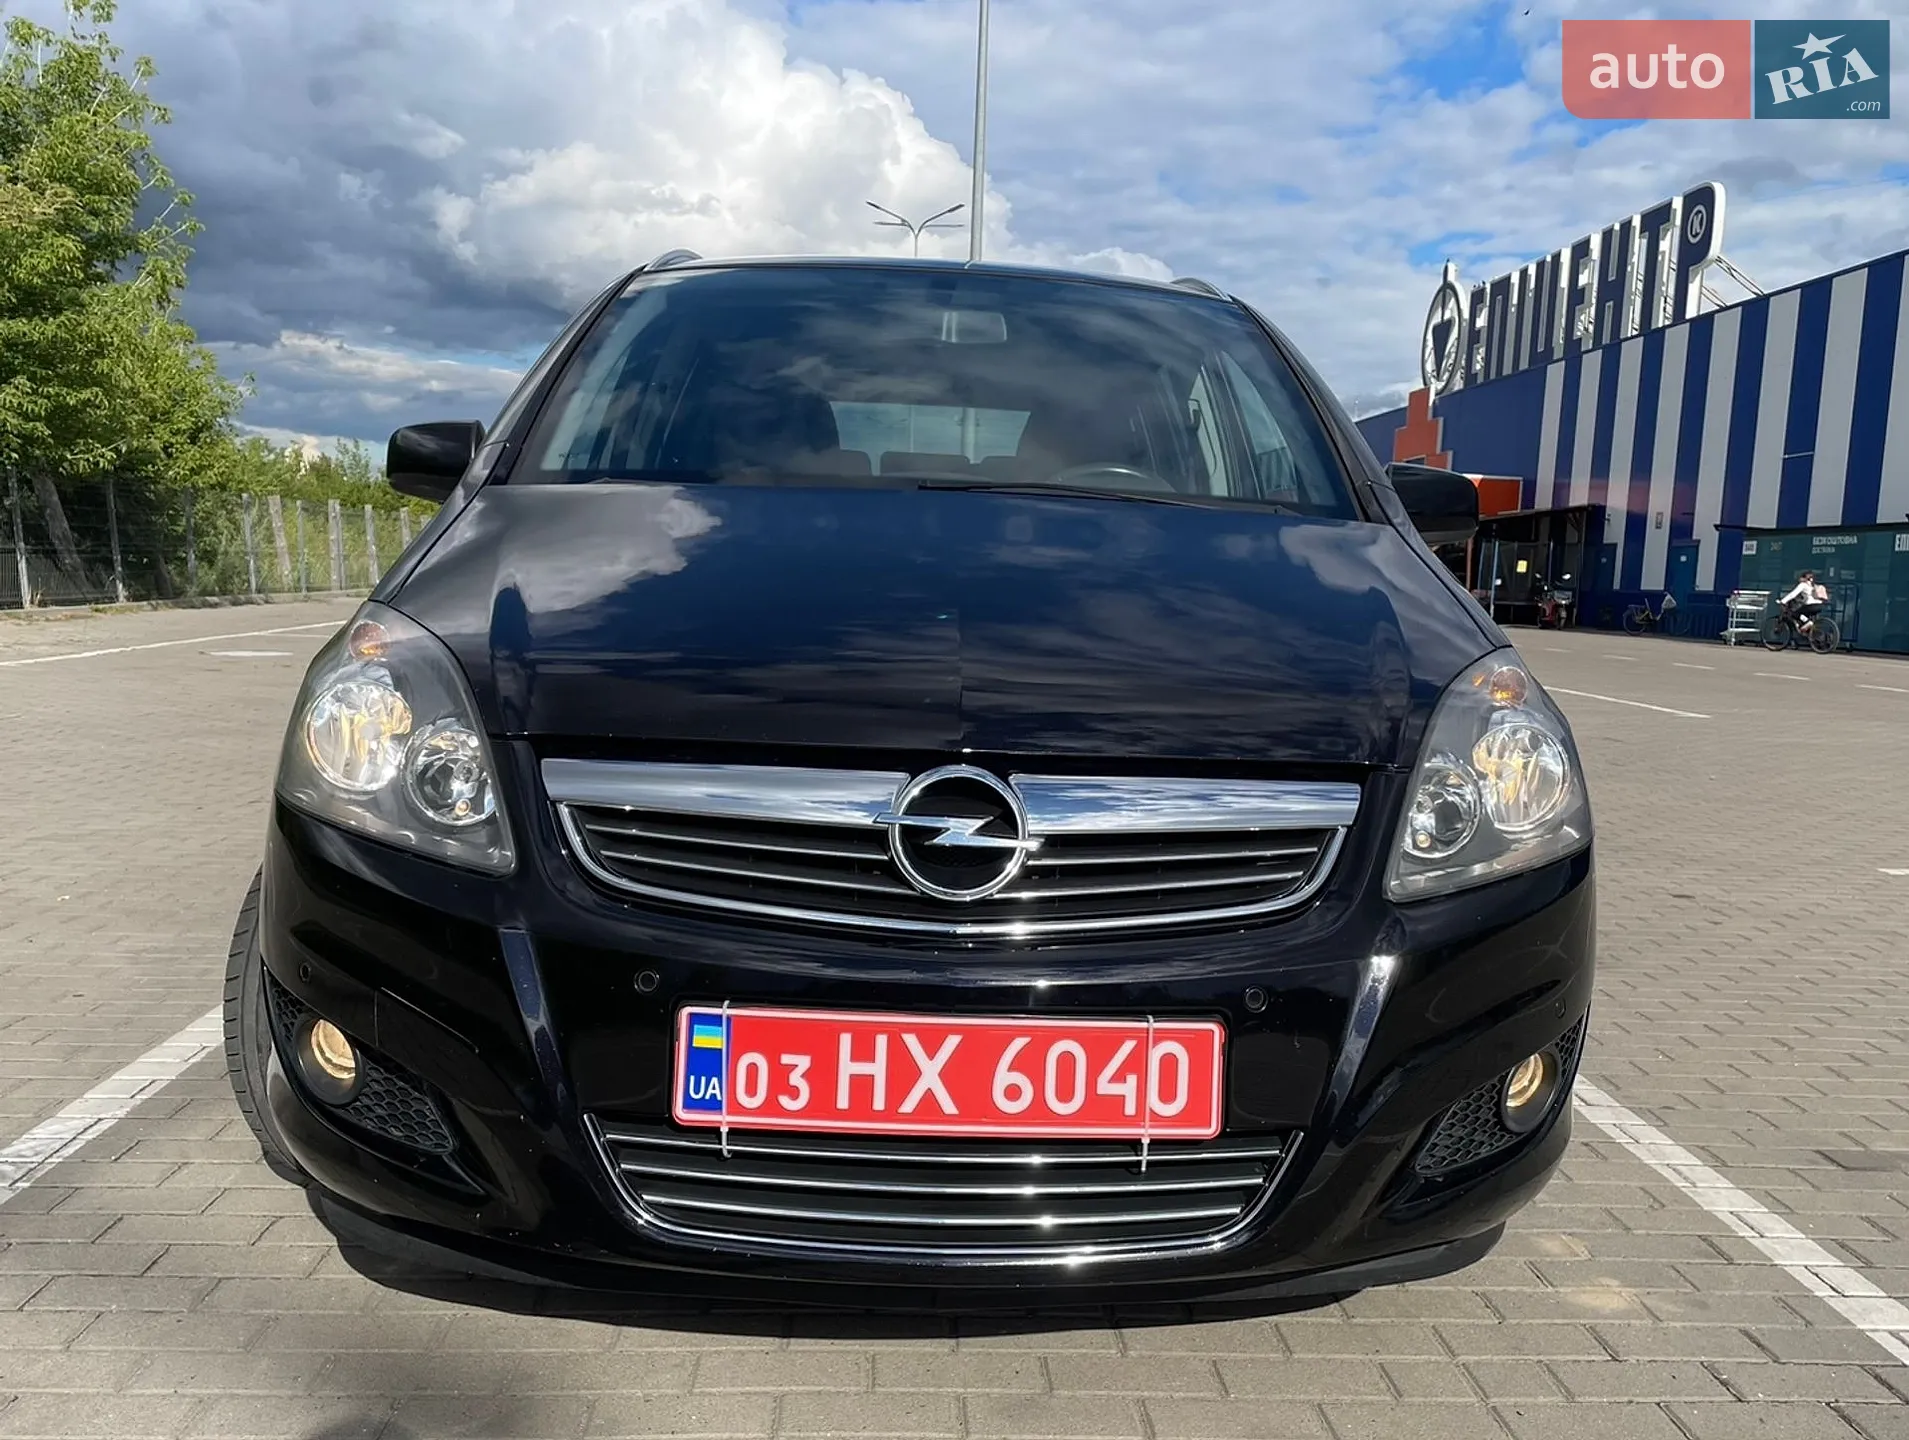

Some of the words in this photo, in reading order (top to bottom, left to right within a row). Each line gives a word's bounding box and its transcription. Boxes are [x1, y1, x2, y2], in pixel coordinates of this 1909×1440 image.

[689, 1075, 722, 1100] UA
[735, 1051, 812, 1111] 03
[836, 1032, 963, 1115] HX
[991, 1036, 1190, 1117] 6040
